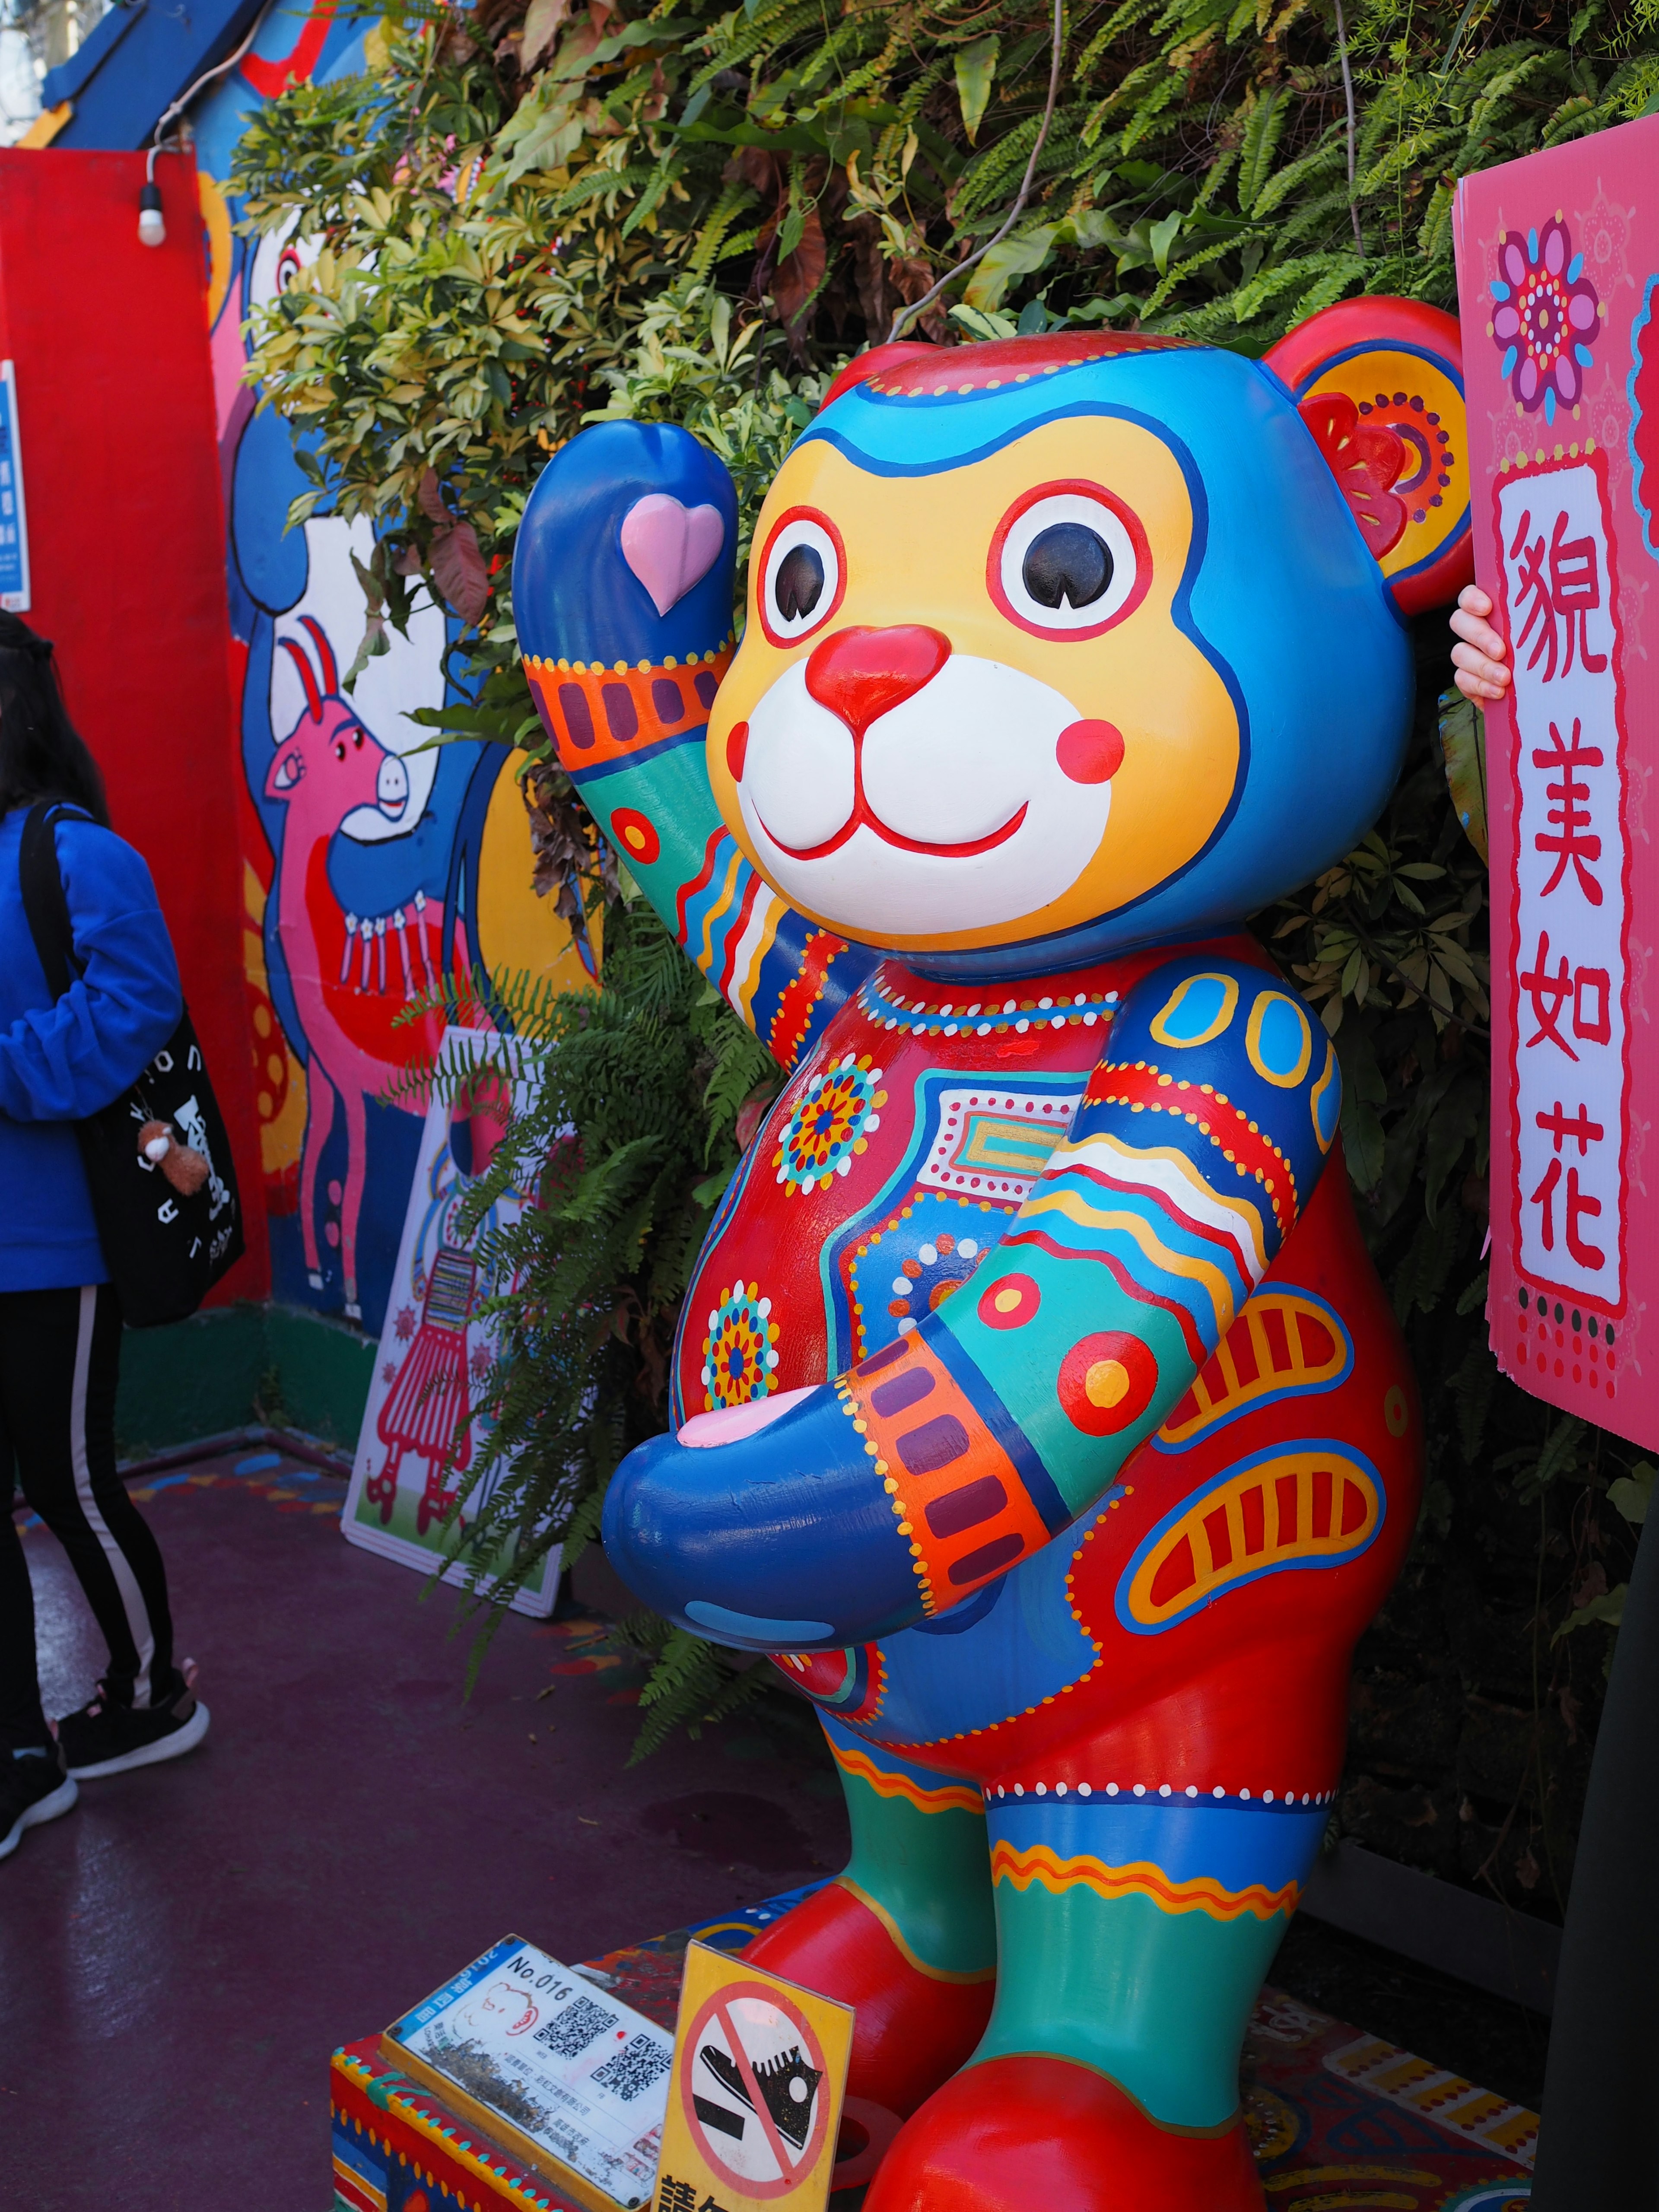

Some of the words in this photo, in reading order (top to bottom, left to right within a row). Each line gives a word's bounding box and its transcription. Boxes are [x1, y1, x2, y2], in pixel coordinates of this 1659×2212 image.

[1510, 509, 1611, 1271] 貌美如花
[507, 1956, 574, 2001] No.016
